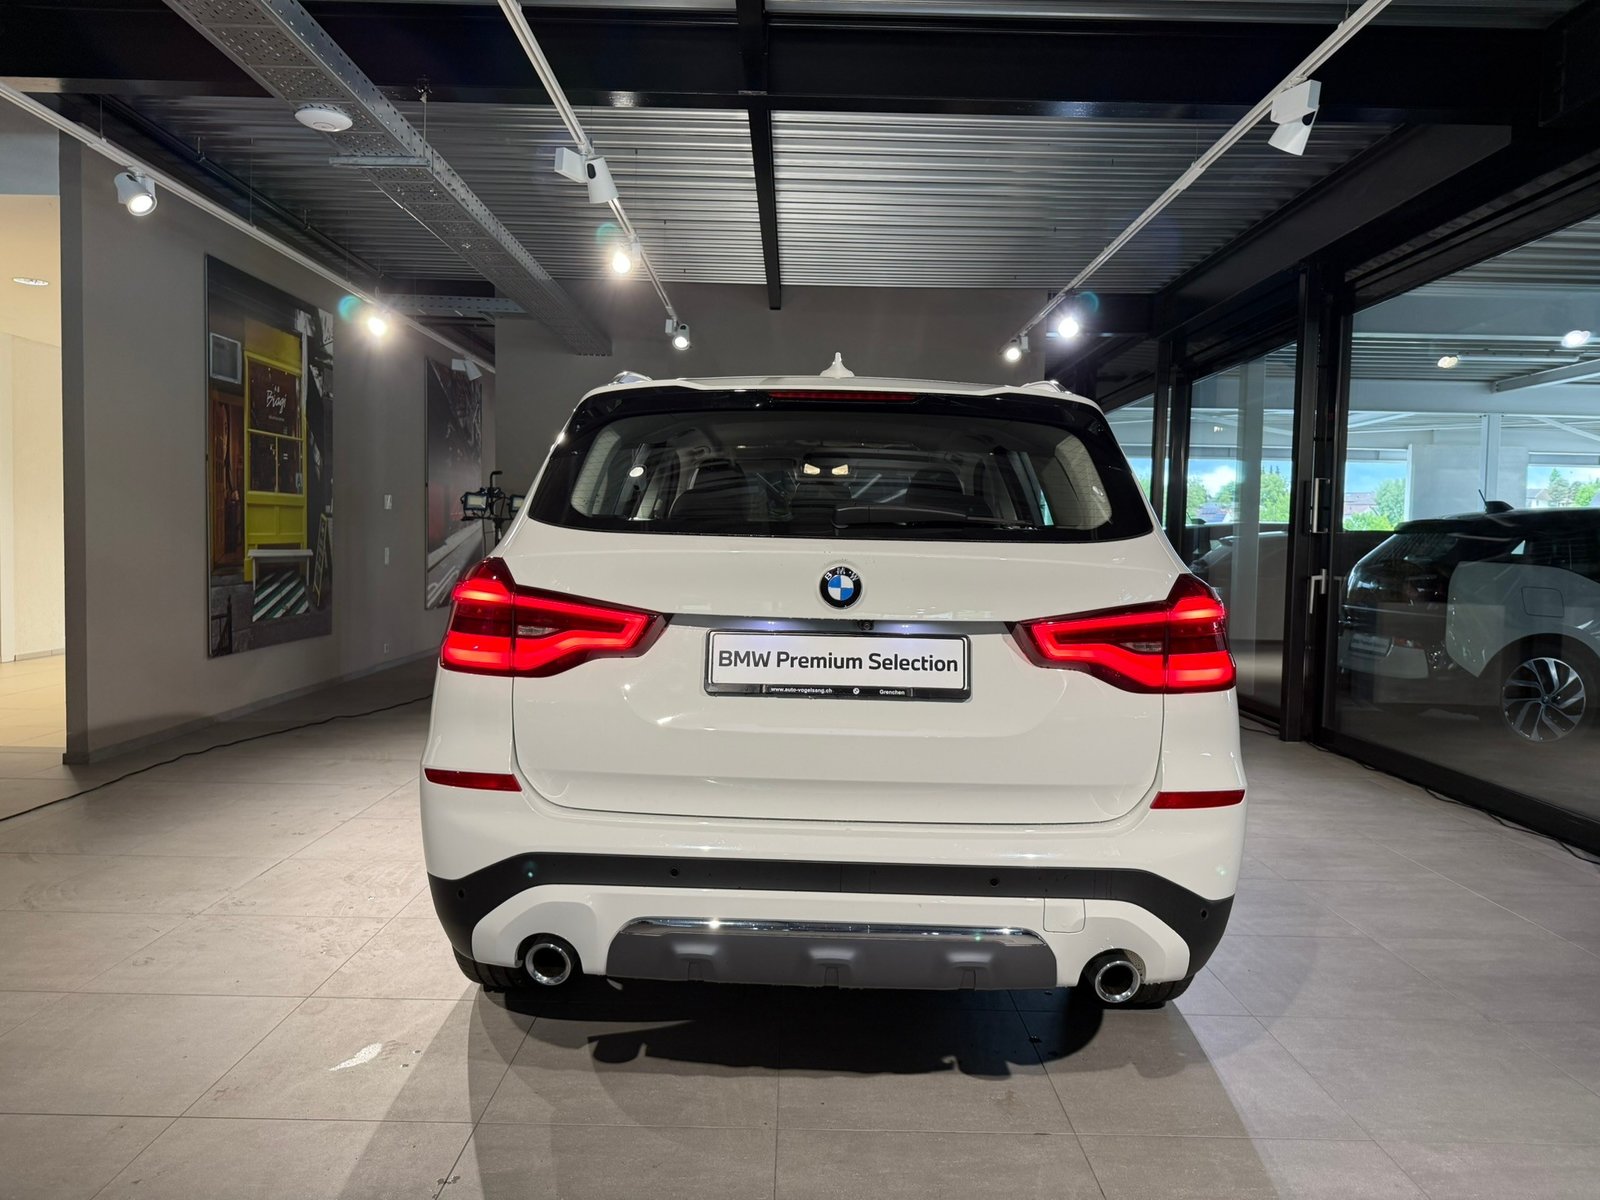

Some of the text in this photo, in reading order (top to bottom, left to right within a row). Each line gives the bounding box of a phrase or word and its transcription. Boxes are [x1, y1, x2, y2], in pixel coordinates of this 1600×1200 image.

[824, 567, 859, 581] BMW
[718, 650, 958, 672] BMW Premium Selection
